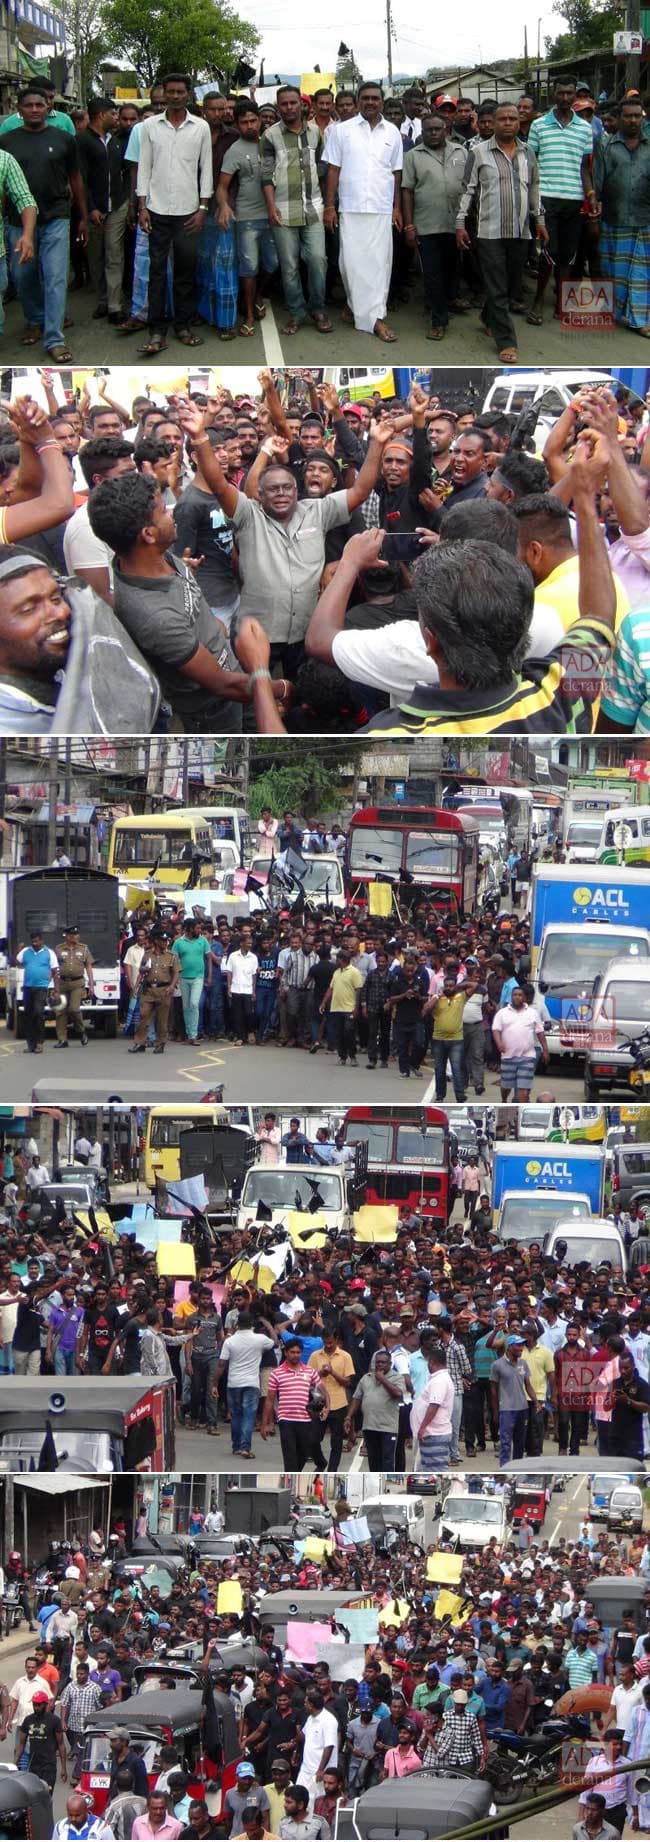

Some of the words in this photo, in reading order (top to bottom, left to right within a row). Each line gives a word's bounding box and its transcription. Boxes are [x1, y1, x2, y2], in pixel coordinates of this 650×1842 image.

[591, 888, 630, 907] ACL
[571, 907, 630, 917] CABLES
[541, 1162, 572, 1177] ACL
[525, 1177, 573, 1185] CABLES
